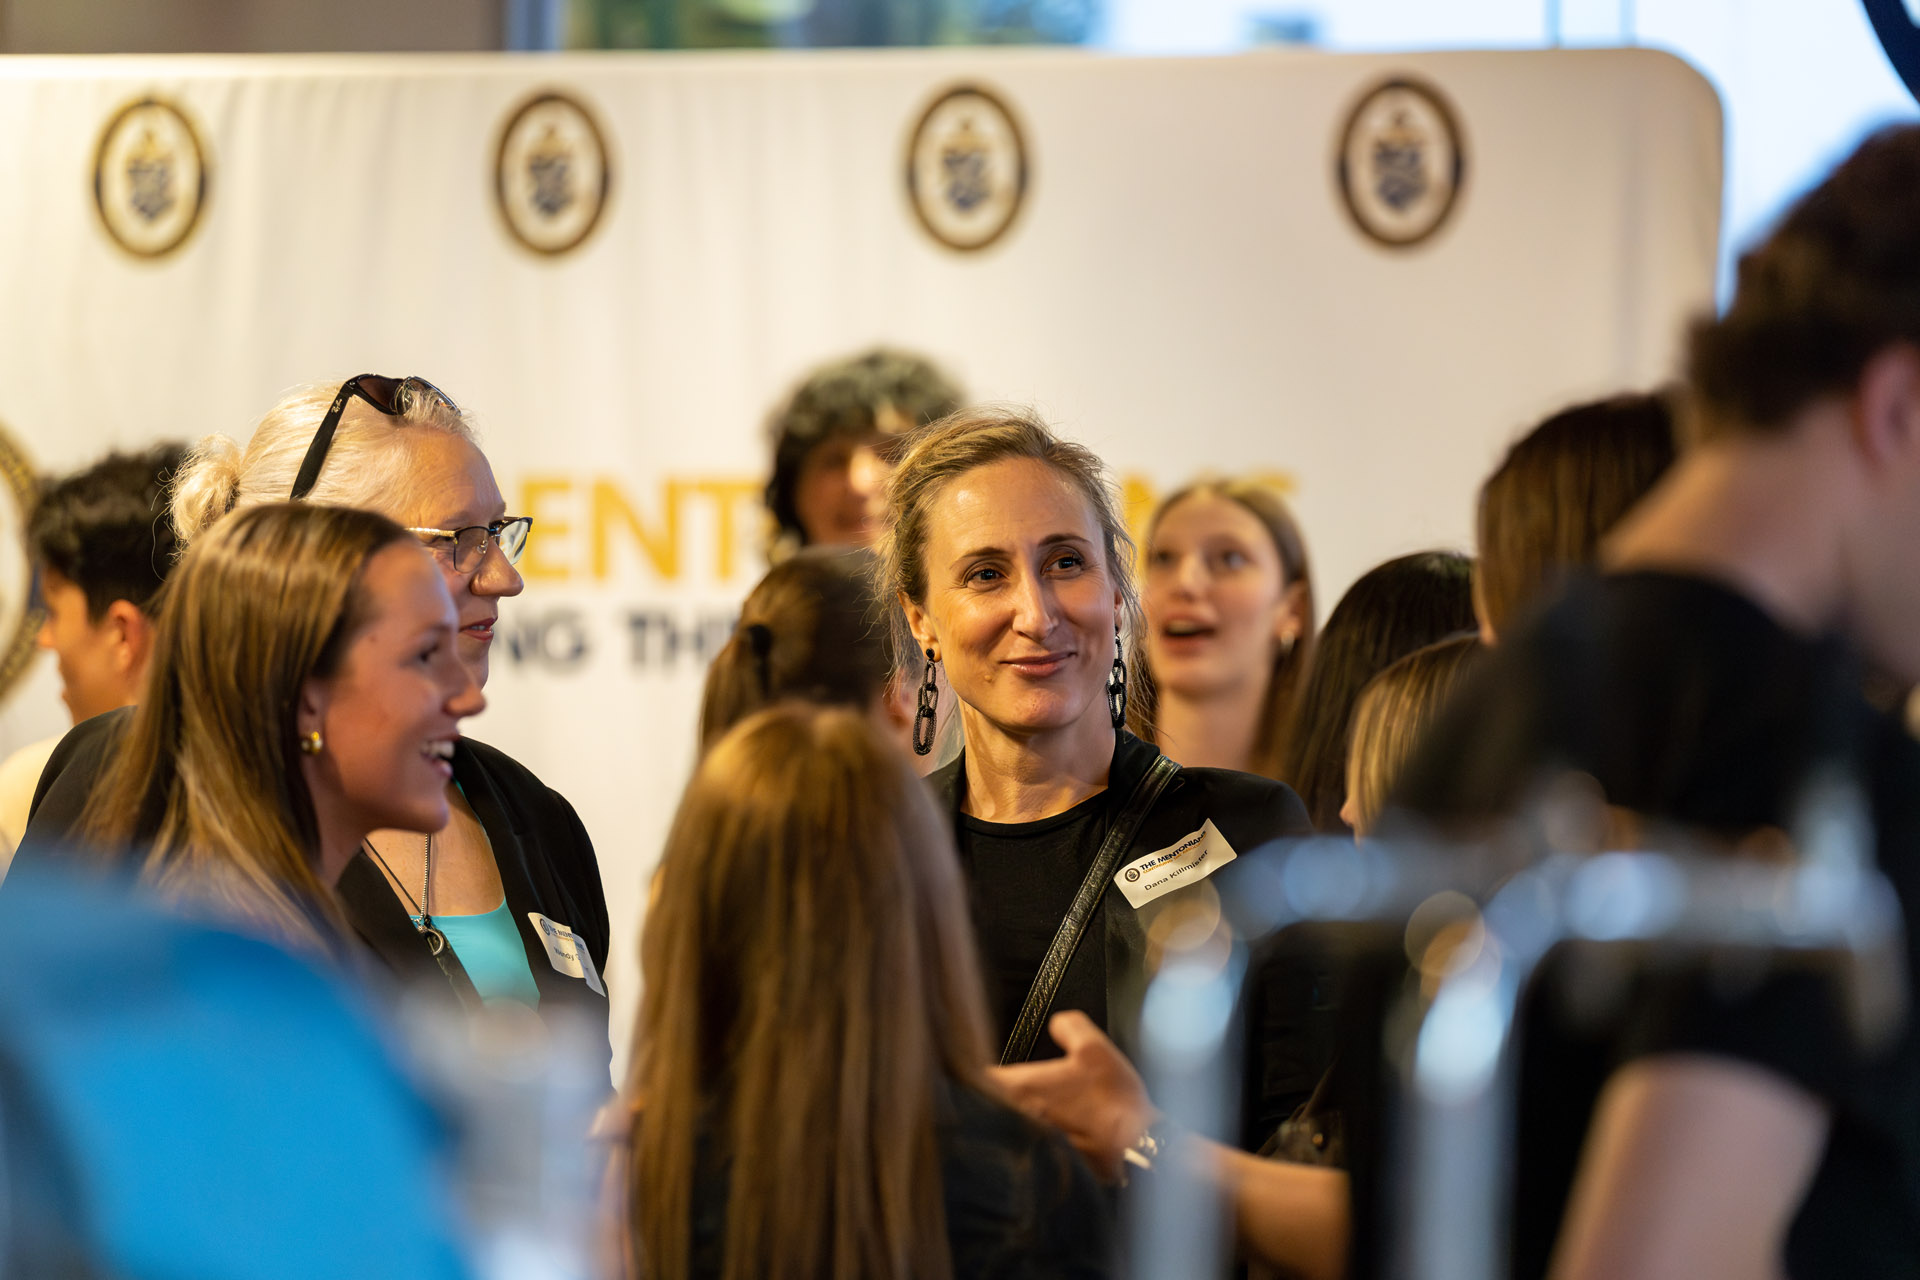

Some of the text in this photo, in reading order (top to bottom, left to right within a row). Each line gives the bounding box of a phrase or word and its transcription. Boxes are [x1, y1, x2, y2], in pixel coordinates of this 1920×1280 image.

[1140, 859, 1157, 871] THE
[1144, 877, 1169, 891] Dana
[1169, 849, 1208, 879] Killmister
